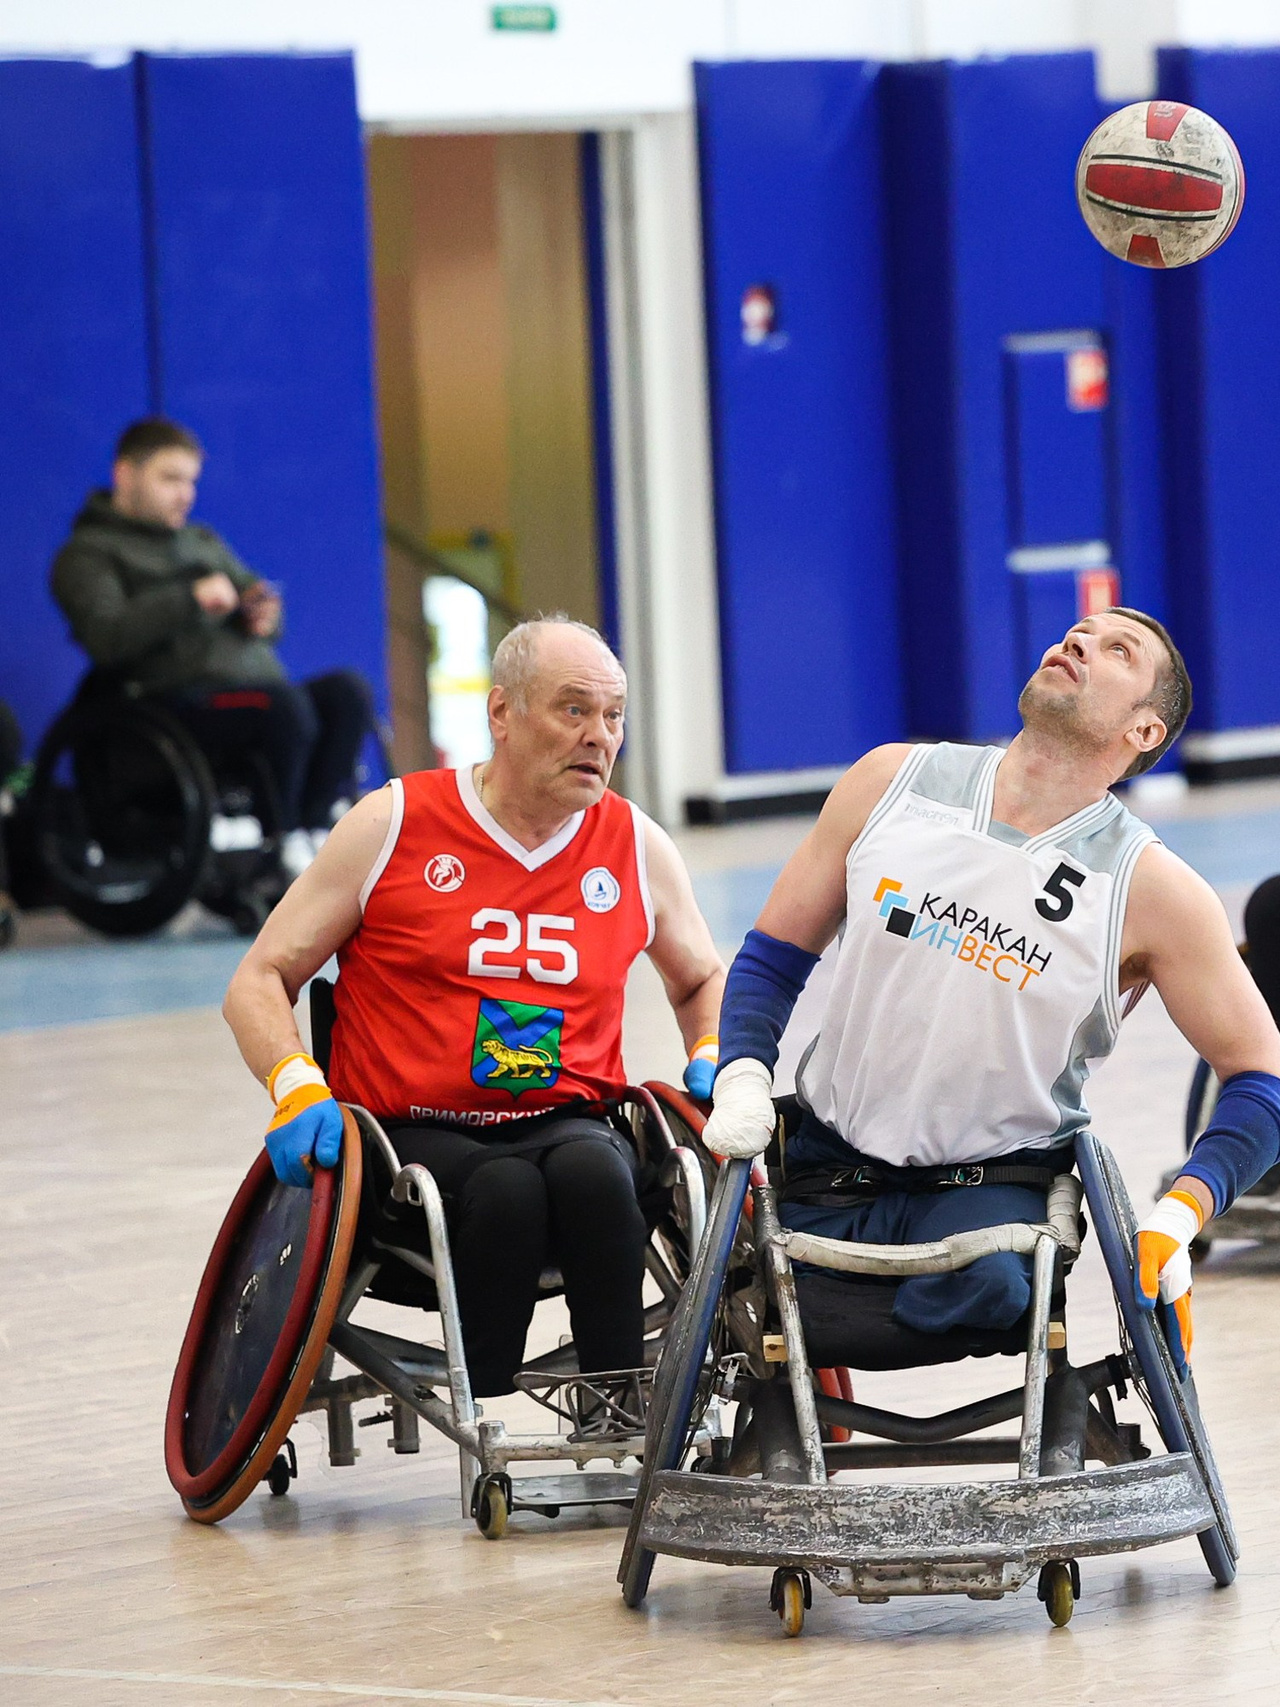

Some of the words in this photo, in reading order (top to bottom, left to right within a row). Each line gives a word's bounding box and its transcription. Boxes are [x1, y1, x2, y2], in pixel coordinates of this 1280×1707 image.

[1034, 861, 1087, 923] 5
[467, 907, 579, 986] 25
[910, 915, 1041, 992] ИНВЕСТ
[919, 892, 1053, 973] КАРАКАН
[409, 1104, 555, 1127] ПРИМОРСК
